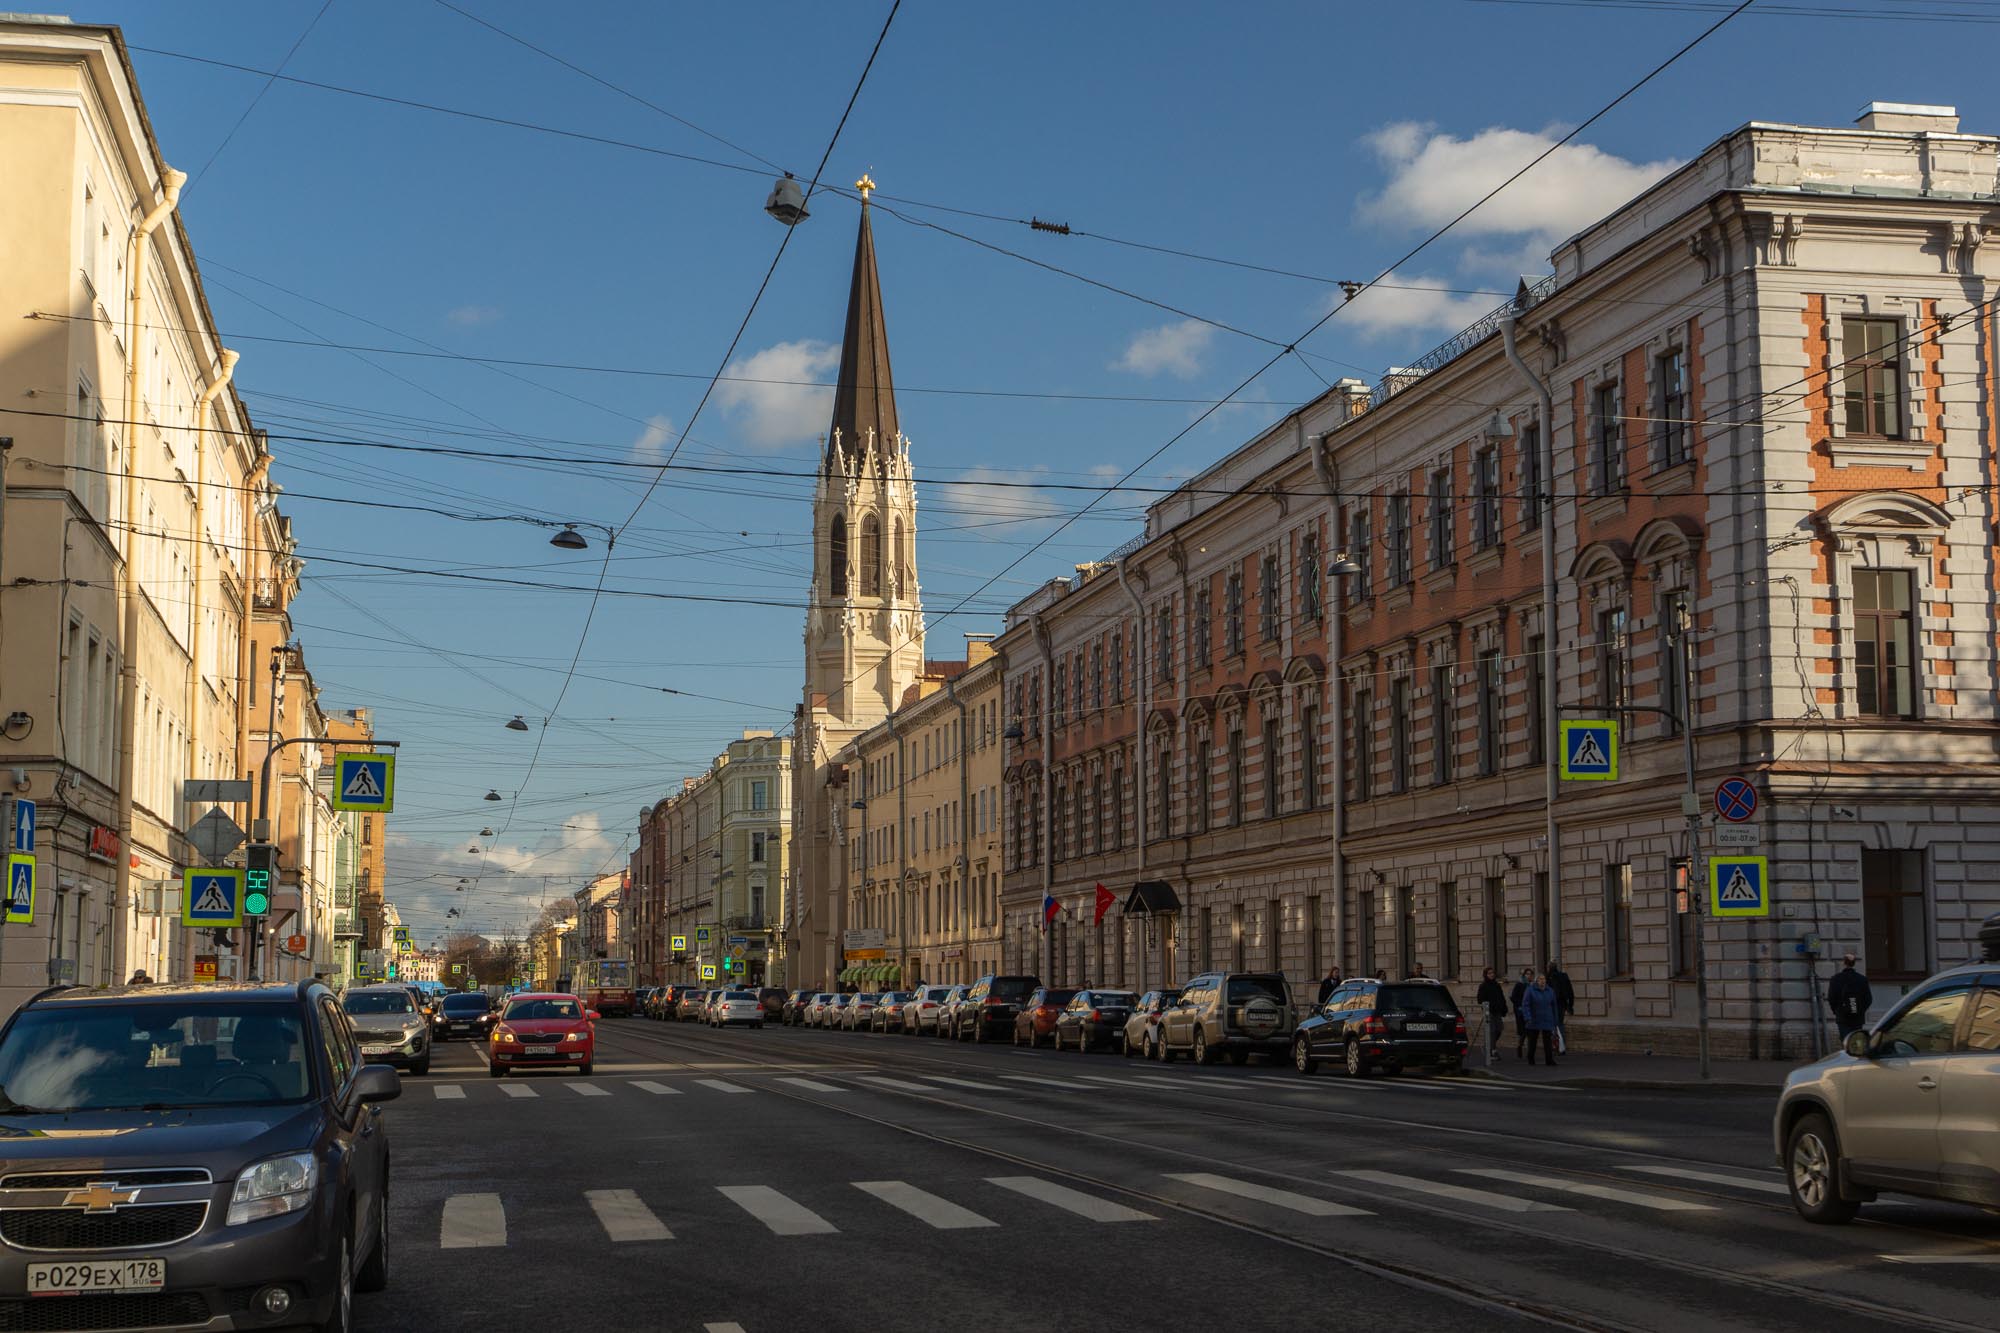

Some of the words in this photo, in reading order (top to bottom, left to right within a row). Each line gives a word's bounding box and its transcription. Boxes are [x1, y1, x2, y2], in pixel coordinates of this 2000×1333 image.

[248, 870, 269, 888] 52
[127, 1263, 158, 1278] 178
[132, 1278, 150, 1286] RUS
